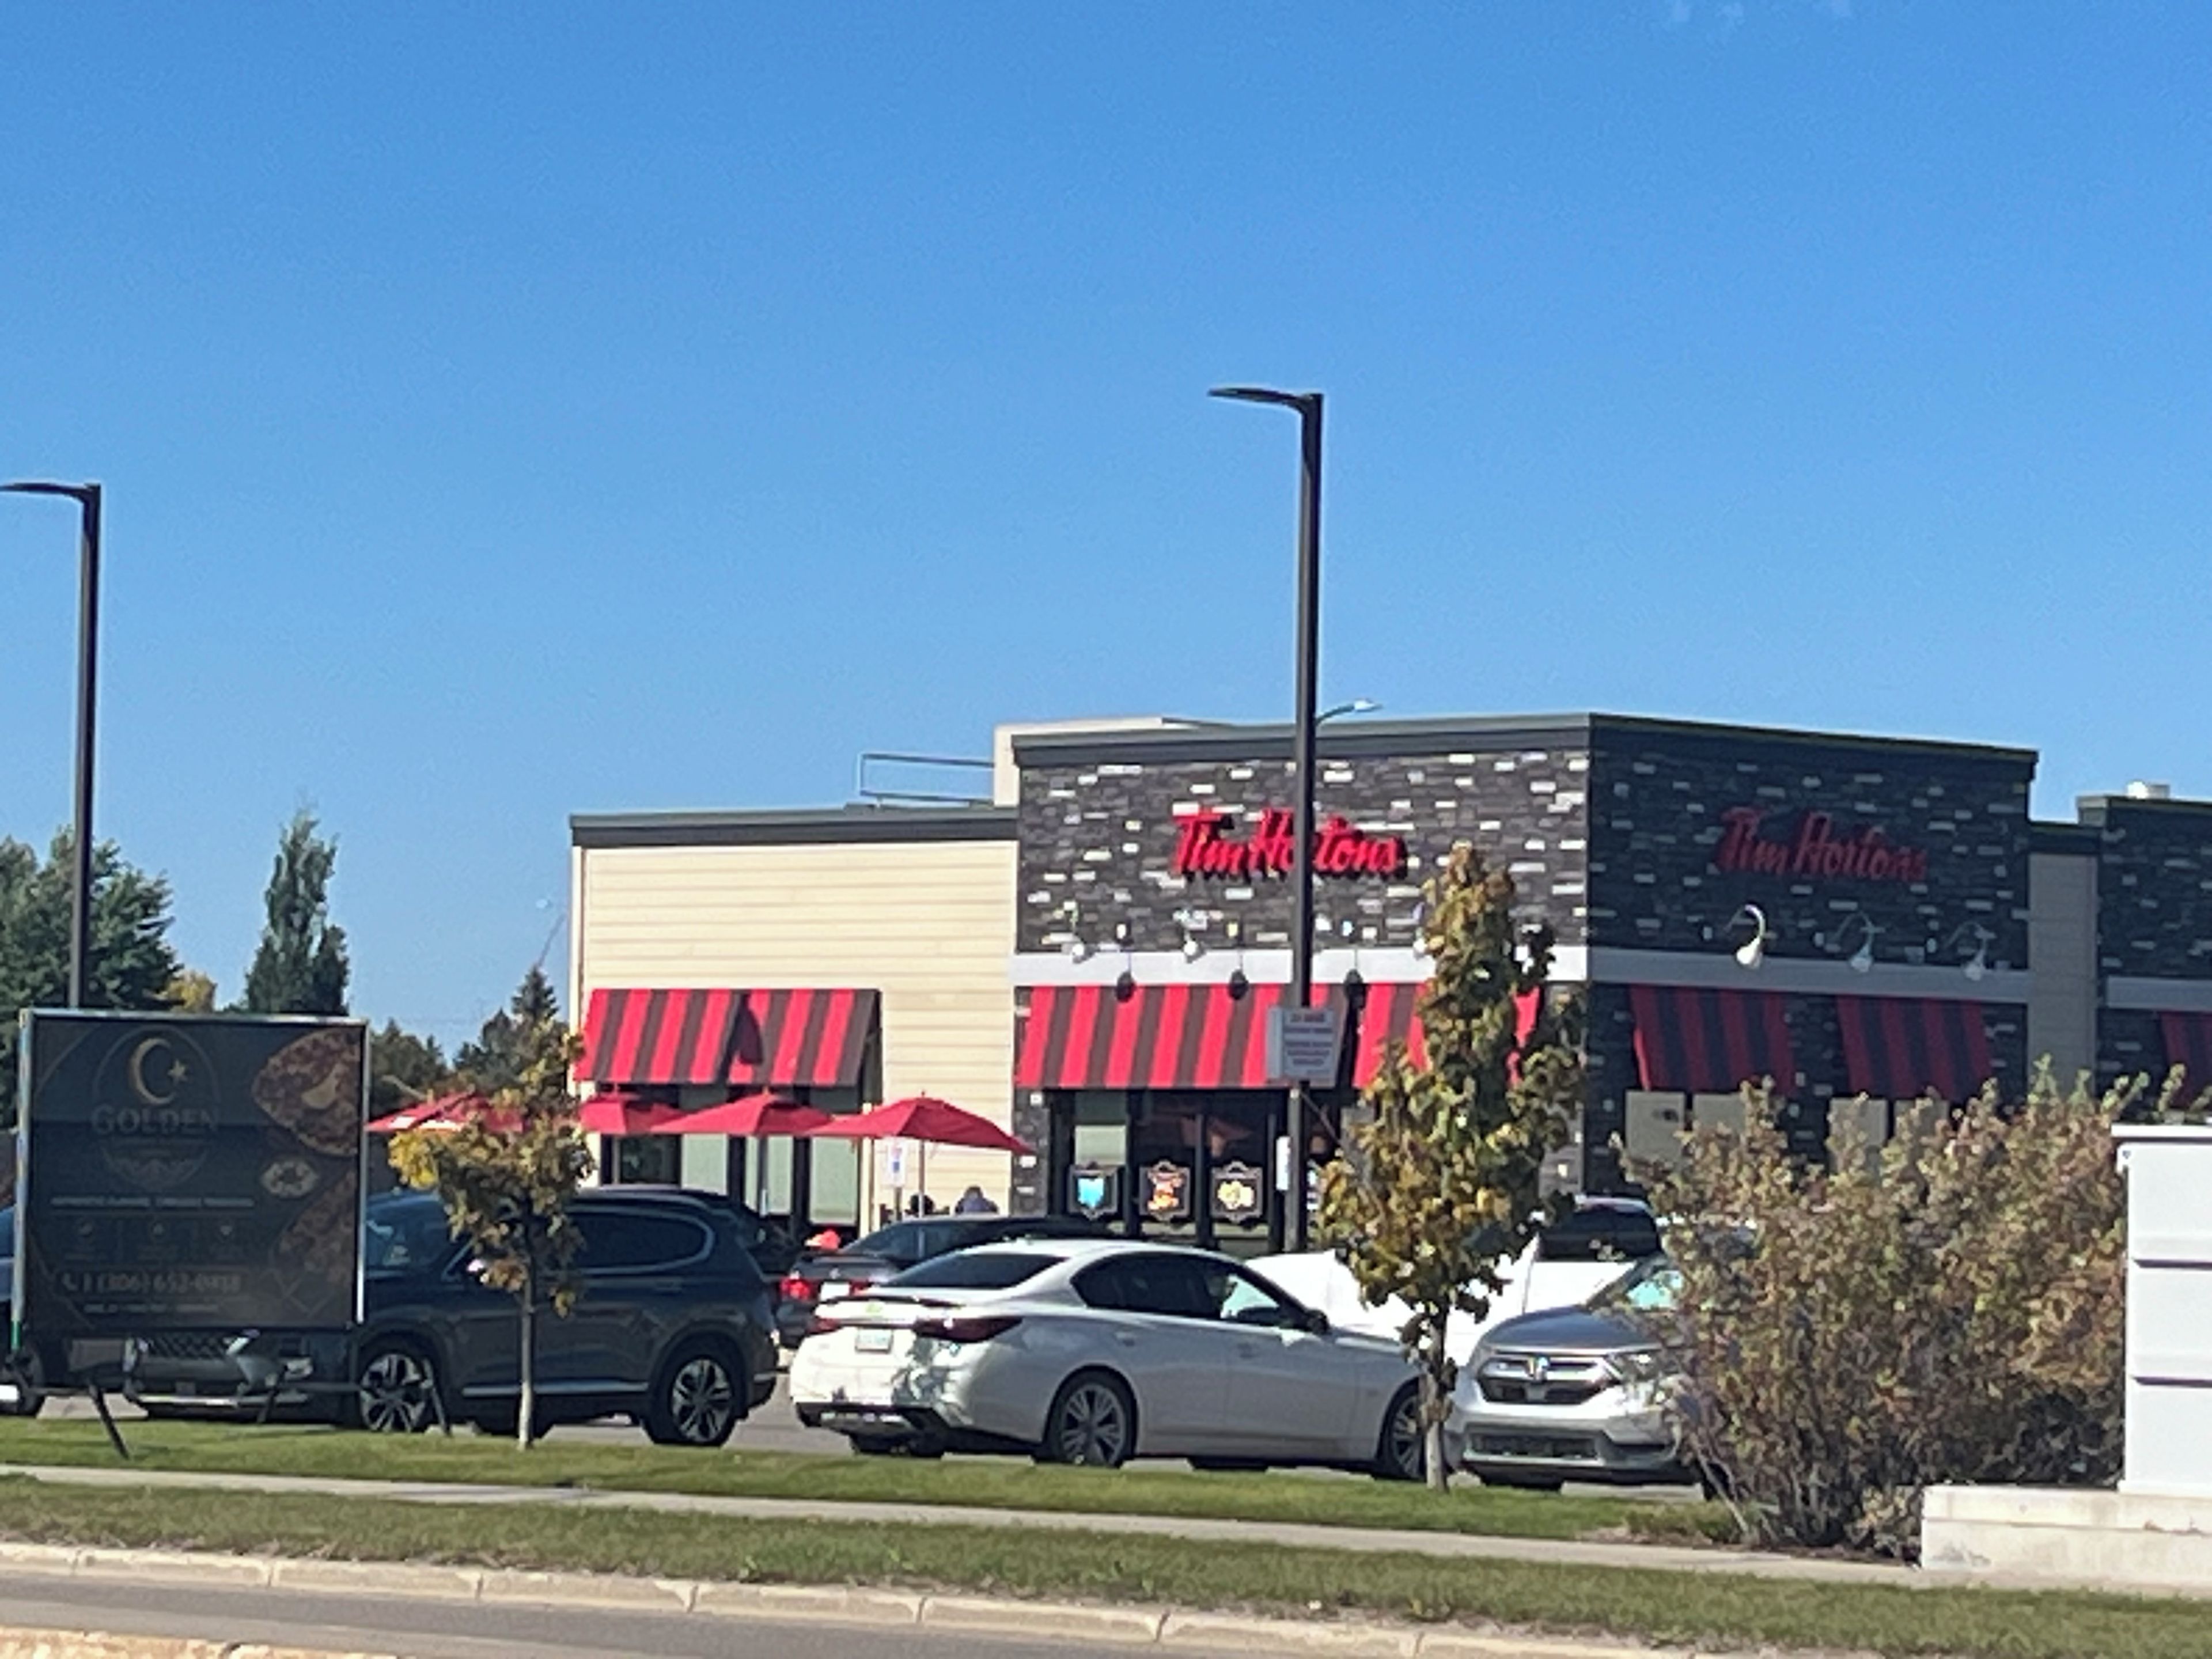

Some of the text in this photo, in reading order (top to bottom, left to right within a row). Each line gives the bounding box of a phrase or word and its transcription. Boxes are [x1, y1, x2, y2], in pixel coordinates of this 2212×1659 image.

[1172, 806, 1401, 876] Tim Hotons
[1717, 806, 1927, 880] Tim Hortons
[90, 1103, 219, 1135] GOLDEN
